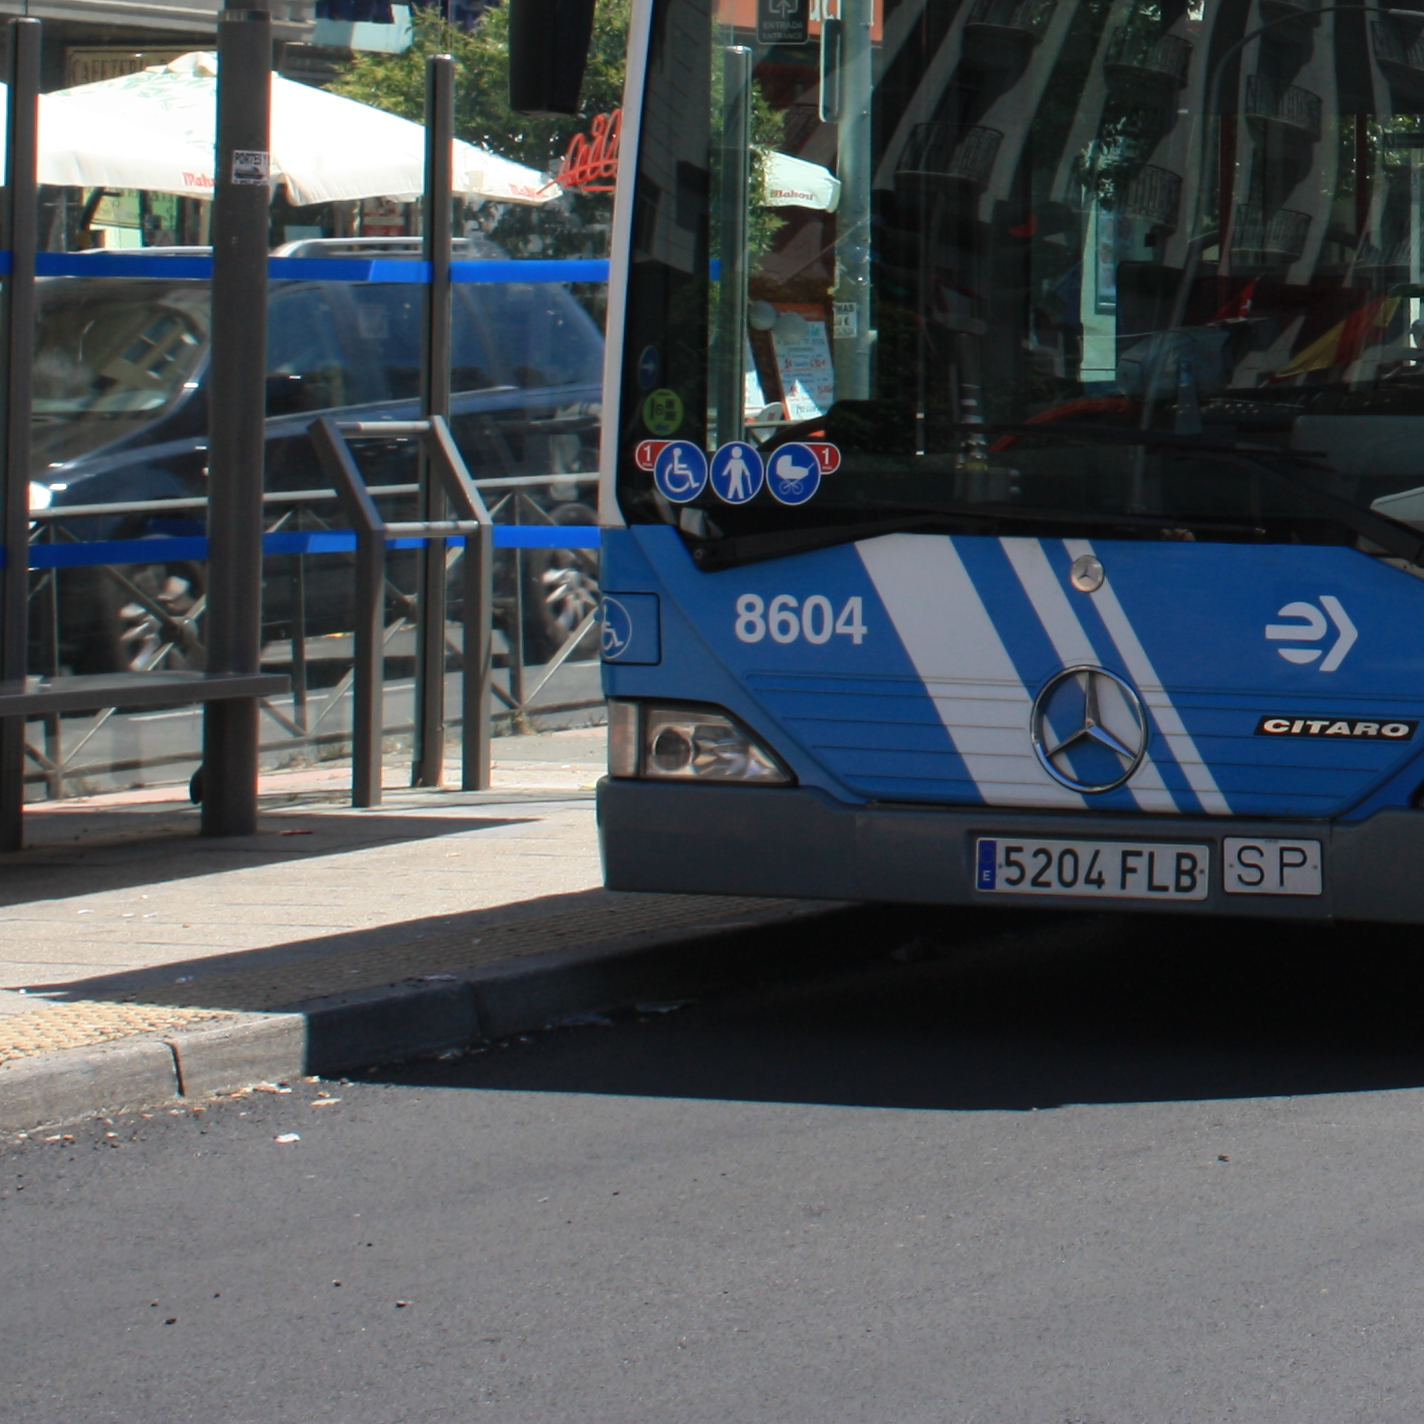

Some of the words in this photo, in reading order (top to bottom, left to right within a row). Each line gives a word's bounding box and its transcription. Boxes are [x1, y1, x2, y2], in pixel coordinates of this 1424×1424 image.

[643, 445, 651, 461] 1
[822, 447, 831, 465] 1
[735, 593, 868, 645] 8604
[1263, 719, 1410, 738] CITARO
[982, 870, 991, 882] E
[1004, 846, 1106, 890] 5204
[1120, 849, 1199, 893] FLB
